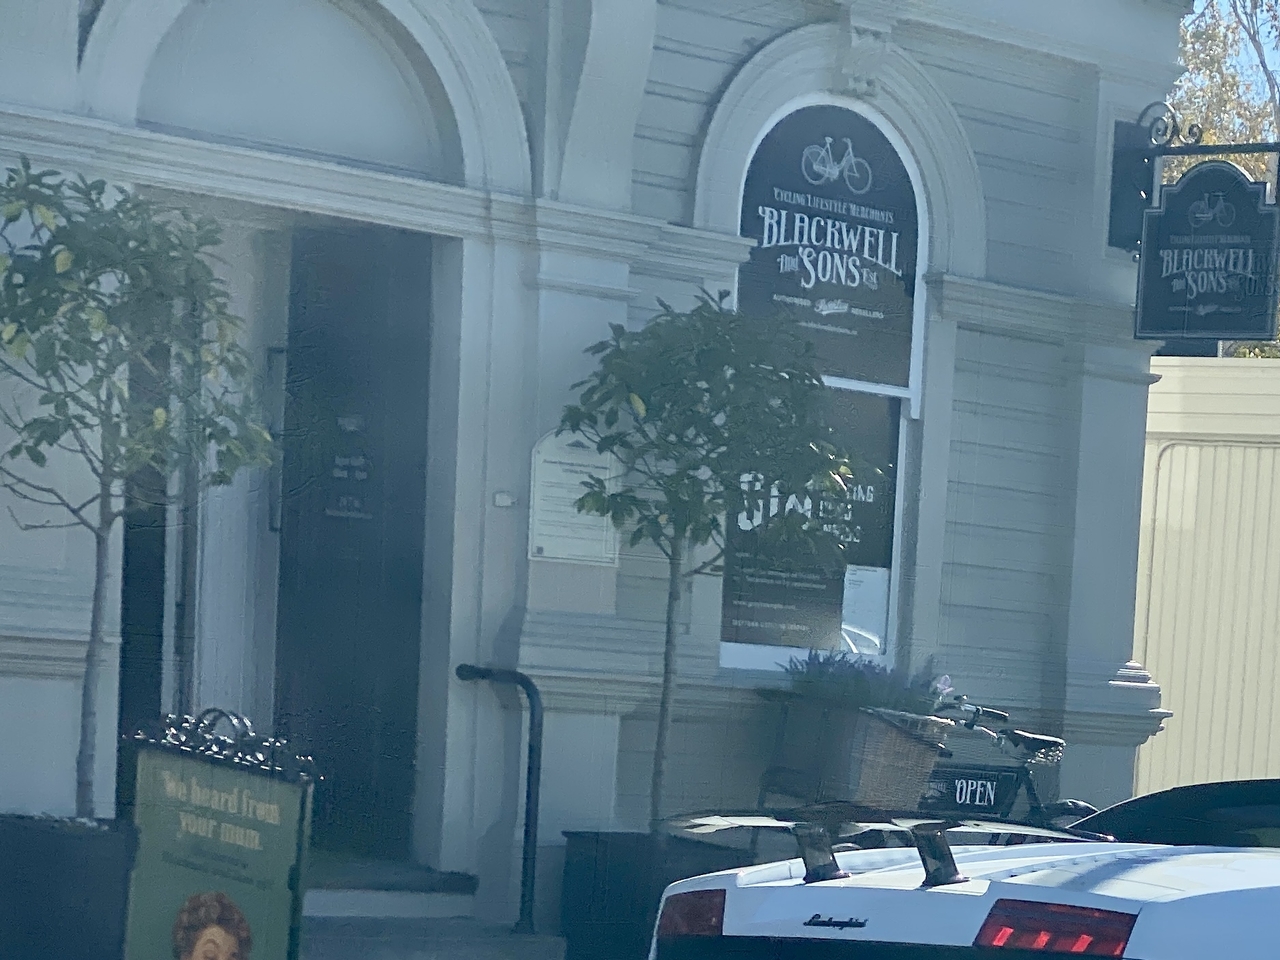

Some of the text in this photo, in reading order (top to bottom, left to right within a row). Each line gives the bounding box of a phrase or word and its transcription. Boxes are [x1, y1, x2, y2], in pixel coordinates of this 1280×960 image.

[758, 205, 902, 277] BLACKWELL
[798, 246, 861, 289] SONS
[1159, 248, 1255, 278] BLACKWELL
[1185, 270, 1227, 300] SONS
[955, 779, 997, 806] OPEN
